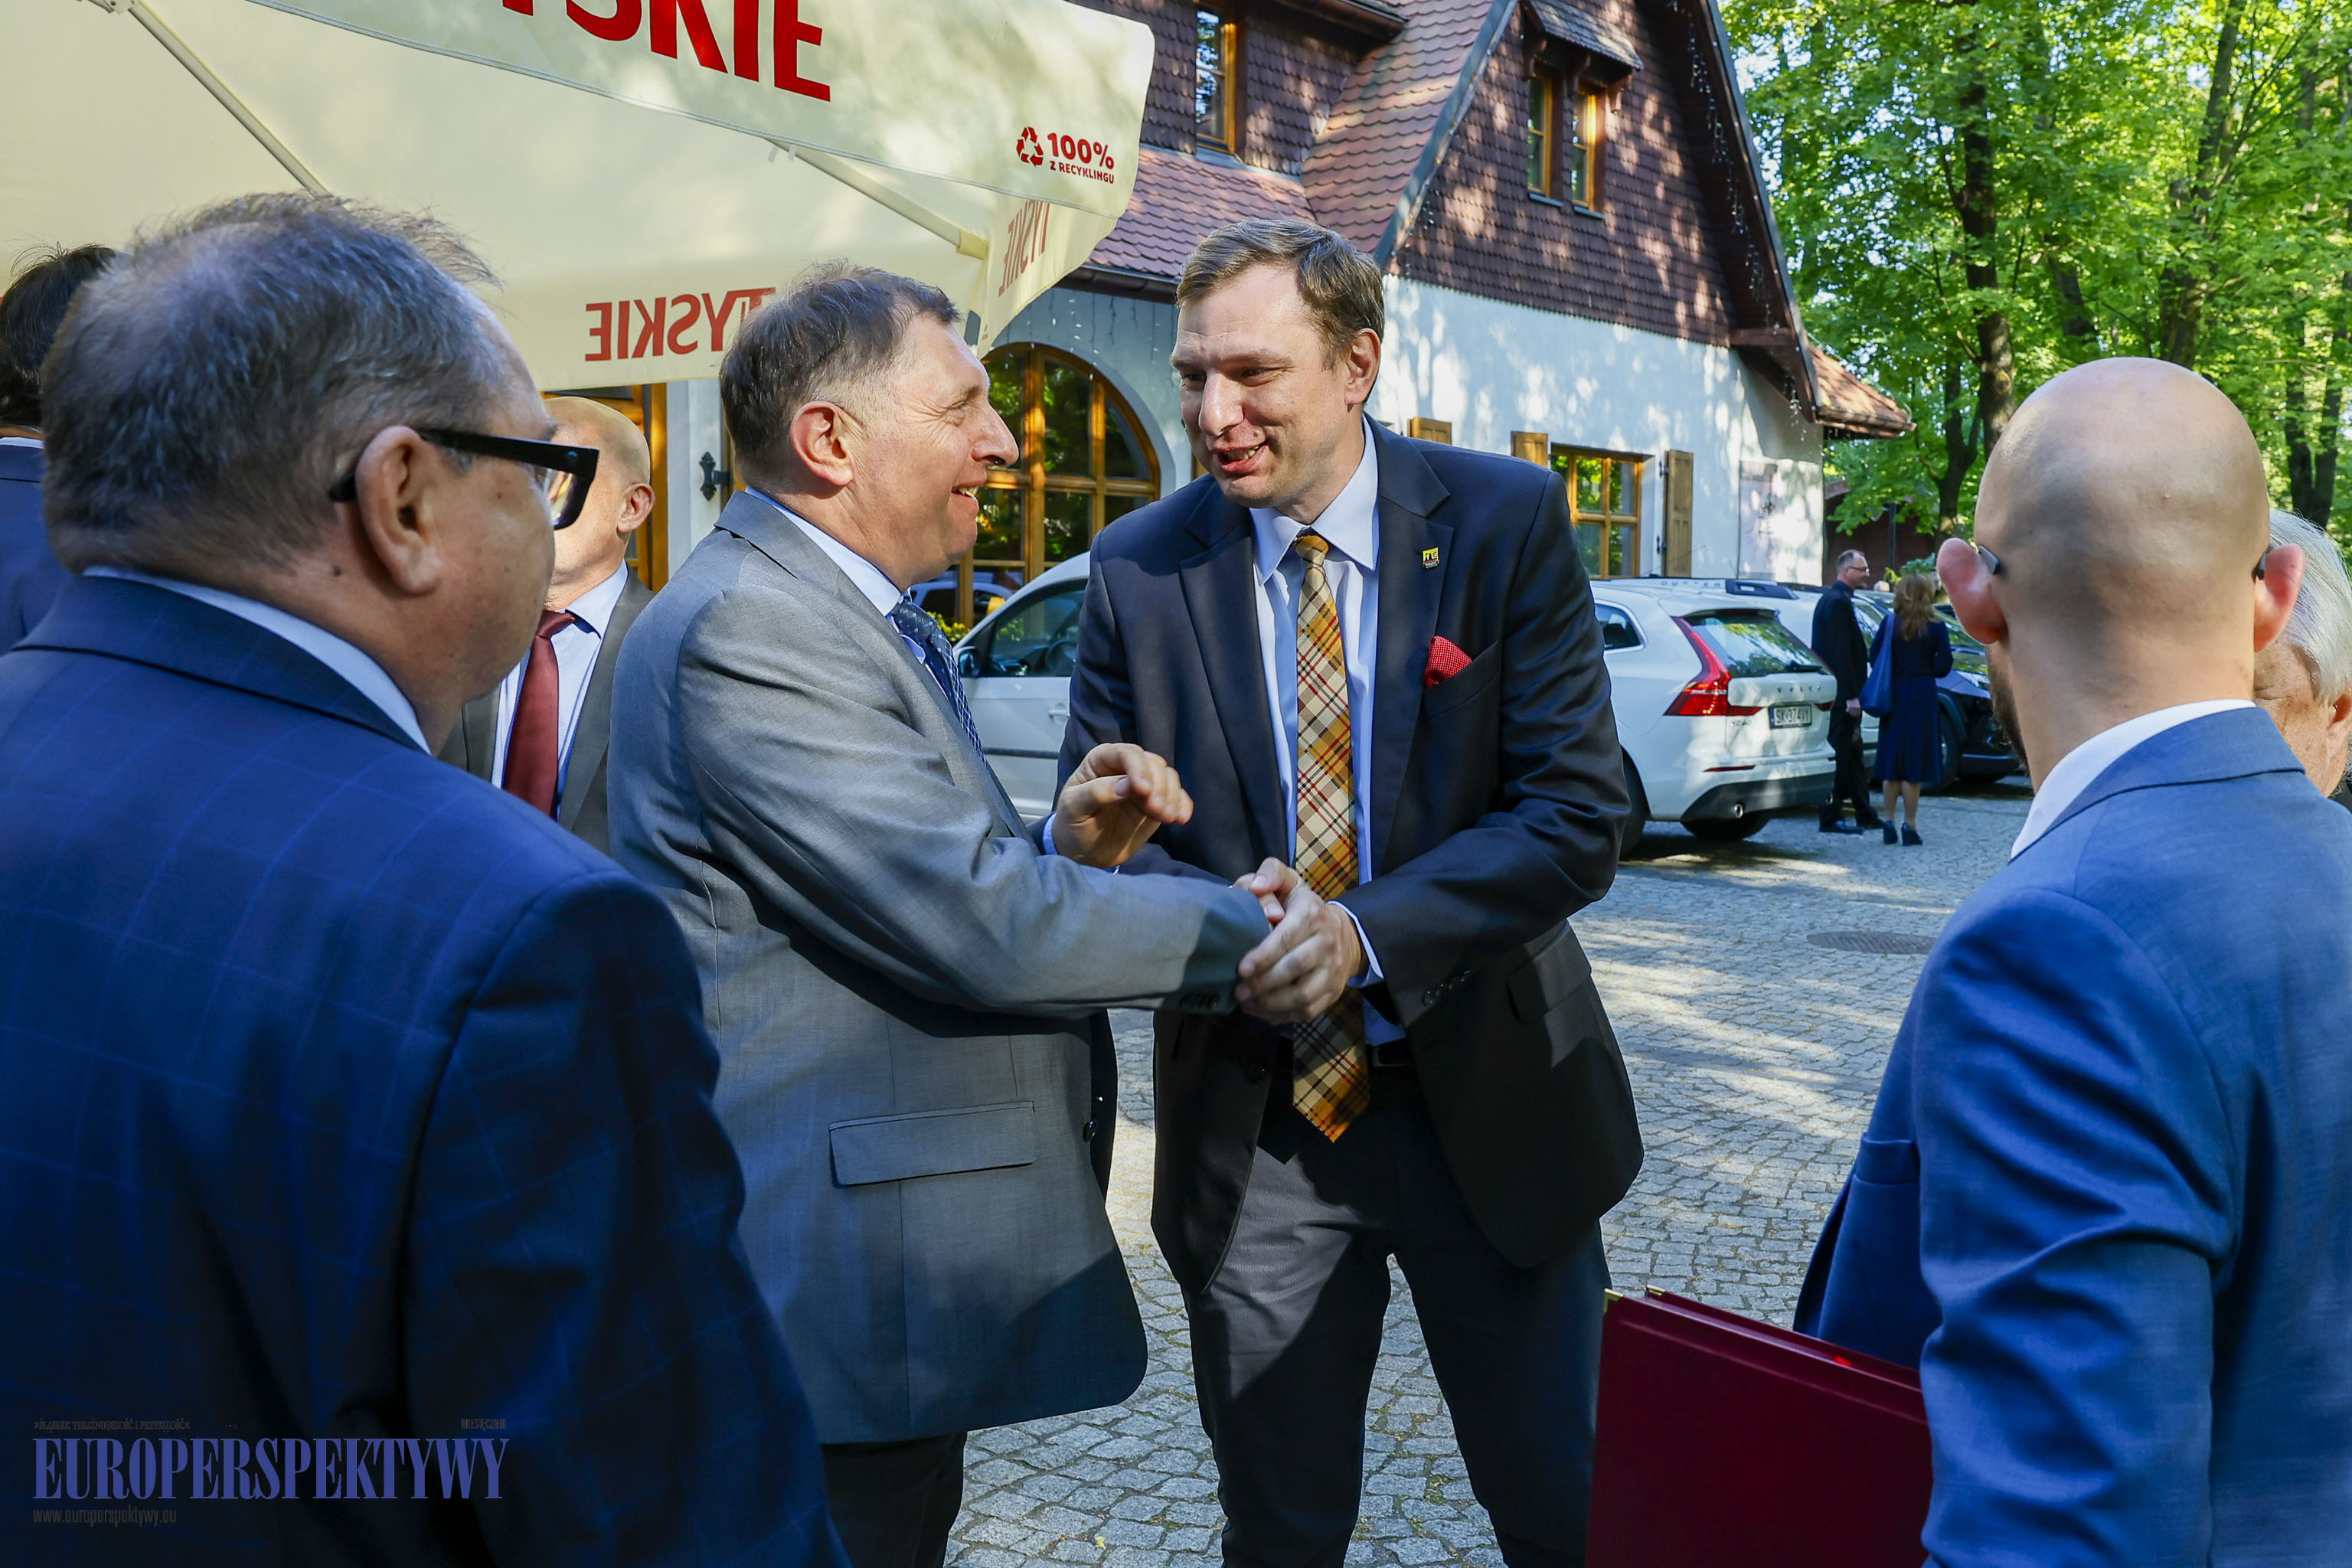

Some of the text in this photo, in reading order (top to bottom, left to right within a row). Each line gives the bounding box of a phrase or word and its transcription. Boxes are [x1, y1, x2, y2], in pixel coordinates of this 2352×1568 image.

[502, 0, 830, 102] KIE
[1047, 132, 1114, 169] 100%
[1050, 160, 1114, 184] Z RECYKLINGU
